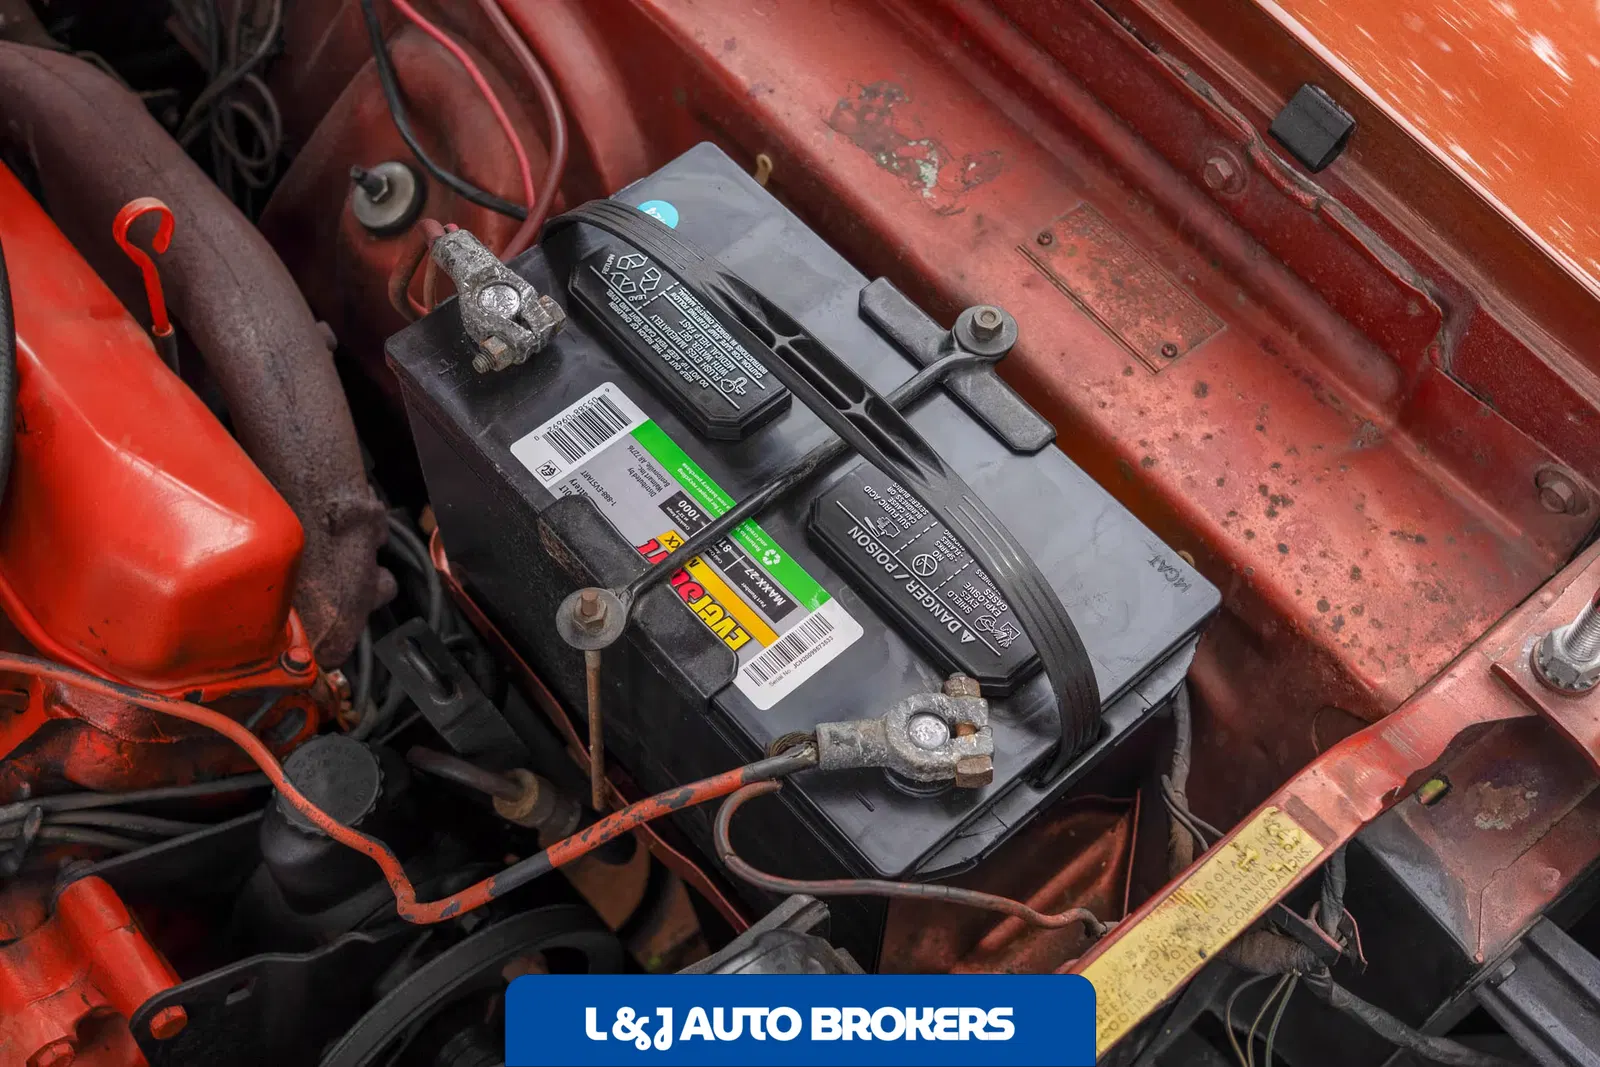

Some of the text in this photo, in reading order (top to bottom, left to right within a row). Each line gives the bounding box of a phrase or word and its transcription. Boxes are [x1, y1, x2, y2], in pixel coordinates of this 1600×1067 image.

[606, 288, 621, 303] LEVEL
[669, 292, 687, 309] FOLLOW
[608, 301, 632, 323] CHILDREN
[618, 301, 631, 312] AND
[628, 312, 644, 326] TIGHT
[629, 322, 639, 330] OF
[685, 305, 710, 329] STARTING
[636, 328, 654, 344] REACH
[642, 324, 656, 337] CAPS
[677, 329, 693, 342] GET
[707, 328, 722, 340] JUMP
[712, 323, 732, 341] VEHICLE
[649, 314, 722, 381] FLUSH EYES IMMEDIATELY
[651, 342, 663, 354] THE
[654, 336, 668, 349] VENT
[678, 318, 736, 371] MEDICAL HELP FAST
[719, 339, 733, 351] SAFE
[666, 348, 681, 361] KEEP
[731, 349, 743, 360] FOR
[735, 344, 768, 374] INSTRUCTIONS
[668, 360, 681, 370] OUT
[710, 360, 728, 376] WITH
[679, 370, 694, 382] KEEP
[688, 369, 701, 380] NOT
[699, 379, 709, 388] DO
[573, 396, 598, 415] 05388
[547, 413, 572, 432] 09692
[627, 444, 641, 458] 72716
[637, 455, 647, 464] AR
[682, 462, 703, 482] purchase
[567, 476, 590, 498] attery
[580, 470, 616, 506] 1-888-EVSTART
[627, 467, 657, 497] Distributed by
[644, 473, 663, 492] Walmart
[677, 468, 719, 509] for proper recycling
[700, 481, 718, 498] battery
[558, 485, 572, 498] OLT
[892, 482, 929, 515] SEVERE BURNS
[678, 500, 700, 521] 1000
[716, 497, 727, 506] new
[863, 485, 911, 529] SULFURIC ACID
[886, 486, 923, 519] BLINDNESS OR
[887, 496, 917, 523] CAN CAUSE
[666, 506, 690, 530] Cranking Amps
[744, 524, 758, 538] credit
[715, 536, 733, 553] 81
[745, 535, 761, 552] Return
[756, 537, 767, 546] and
[847, 526, 898, 572] POISON
[934, 540, 955, 560] SPARKS
[940, 535, 961, 555] FLAMES
[713, 554, 722, 564] Cold
[932, 549, 944, 561] NO
[741, 582, 766, 607] Part Number
[744, 566, 786, 605] MAXX 27
[906, 580, 962, 633] DANGER
[947, 590, 972, 613] SHIELD
[959, 590, 979, 608] EYES
[963, 581, 1001, 617] EXPLOSIVE
[983, 588, 1008, 611] GASES
[768, 672, 784, 687] Serial
[1142, 962, 1165, 983] SEE
[1099, 986, 1158, 1042] COOLING
